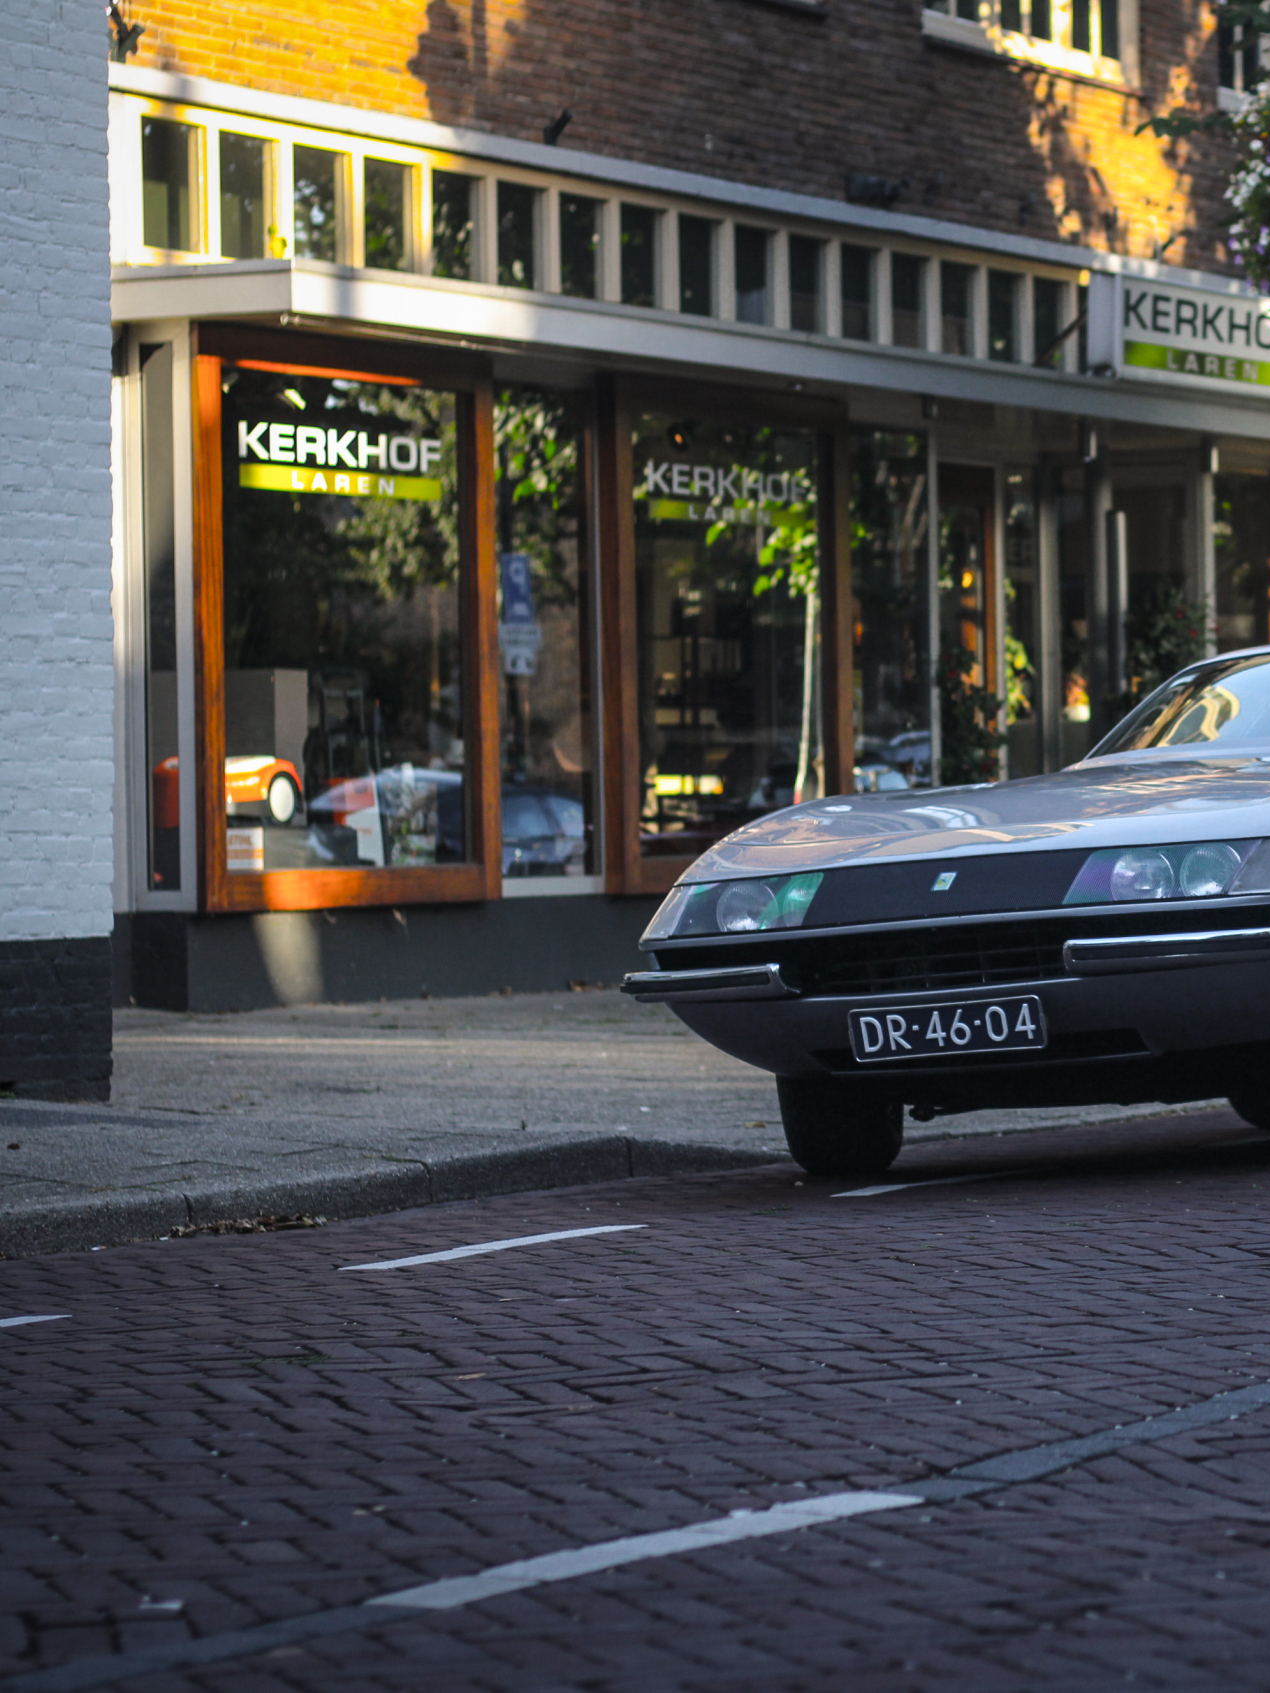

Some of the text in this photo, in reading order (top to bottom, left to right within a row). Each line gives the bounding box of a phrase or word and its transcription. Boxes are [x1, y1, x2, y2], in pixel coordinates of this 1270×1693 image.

[1167, 350, 1260, 382] LAREN
[238, 420, 442, 473] KERKHOF
[292, 470, 395, 496] LAREN
[646, 459, 808, 504] KERKHOF
[688, 504, 772, 526] LAREN
[859, 1003, 1037, 1053] DR-46-04
